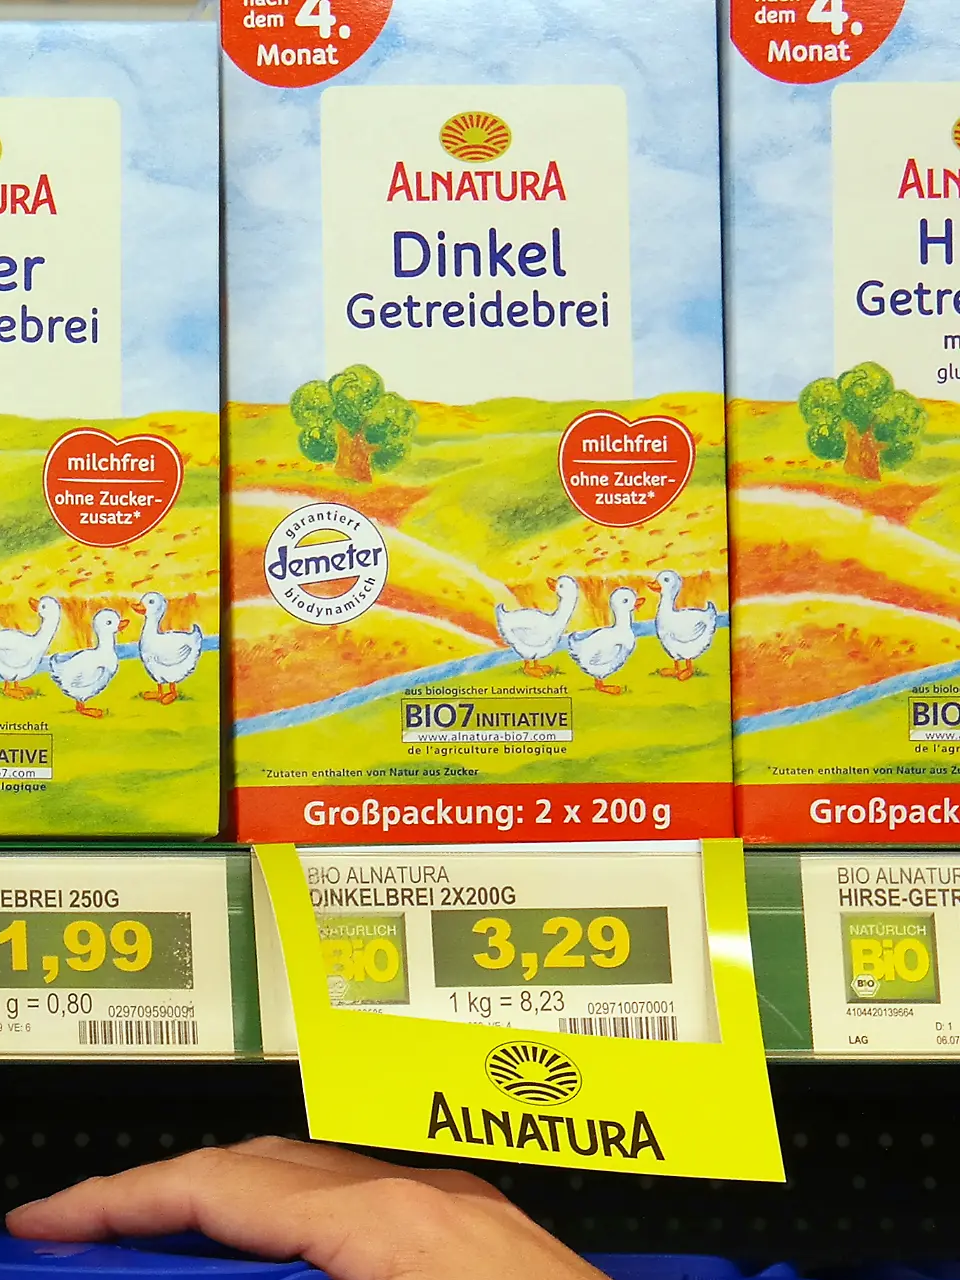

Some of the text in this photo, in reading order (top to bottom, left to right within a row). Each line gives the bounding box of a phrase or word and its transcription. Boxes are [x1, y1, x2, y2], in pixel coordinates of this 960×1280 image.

[243, 0, 351, 39] dem 4.
[256, 44, 338, 66] Monat
[387, 161, 566, 202] ALNATURA
[393, 228, 566, 278] Dinkel
[346, 291, 609, 329] Getreidebrei
[582, 435, 668, 455] milchfrei
[68, 452, 155, 473] milchfrei
[55, 491, 163, 507] ohne Zucker-
[285, 510, 361, 540] garantiert
[268, 543, 382, 580] demeter
[284, 576, 376, 618] biodynamisch
[303, 799, 524, 832] Großpackung:
[535, 799, 552, 824] 2
[563, 804, 581, 824] x
[308, 866, 449, 884] BIO ALNATURA
[69, 889, 119, 908] 250G
[310, 886, 516, 907] DINKELBREI 2X200G
[471, 915, 632, 982] 3,29
[6, 997, 19, 1018] g
[47, 992, 93, 1016] 0,80
[449, 992, 458, 1013] 1
[469, 992, 491, 1017] kg
[521, 991, 565, 1016] 8,23
[587, 1001, 675, 1015] 029710070001
[427, 1092, 665, 1161] ALNATURA
